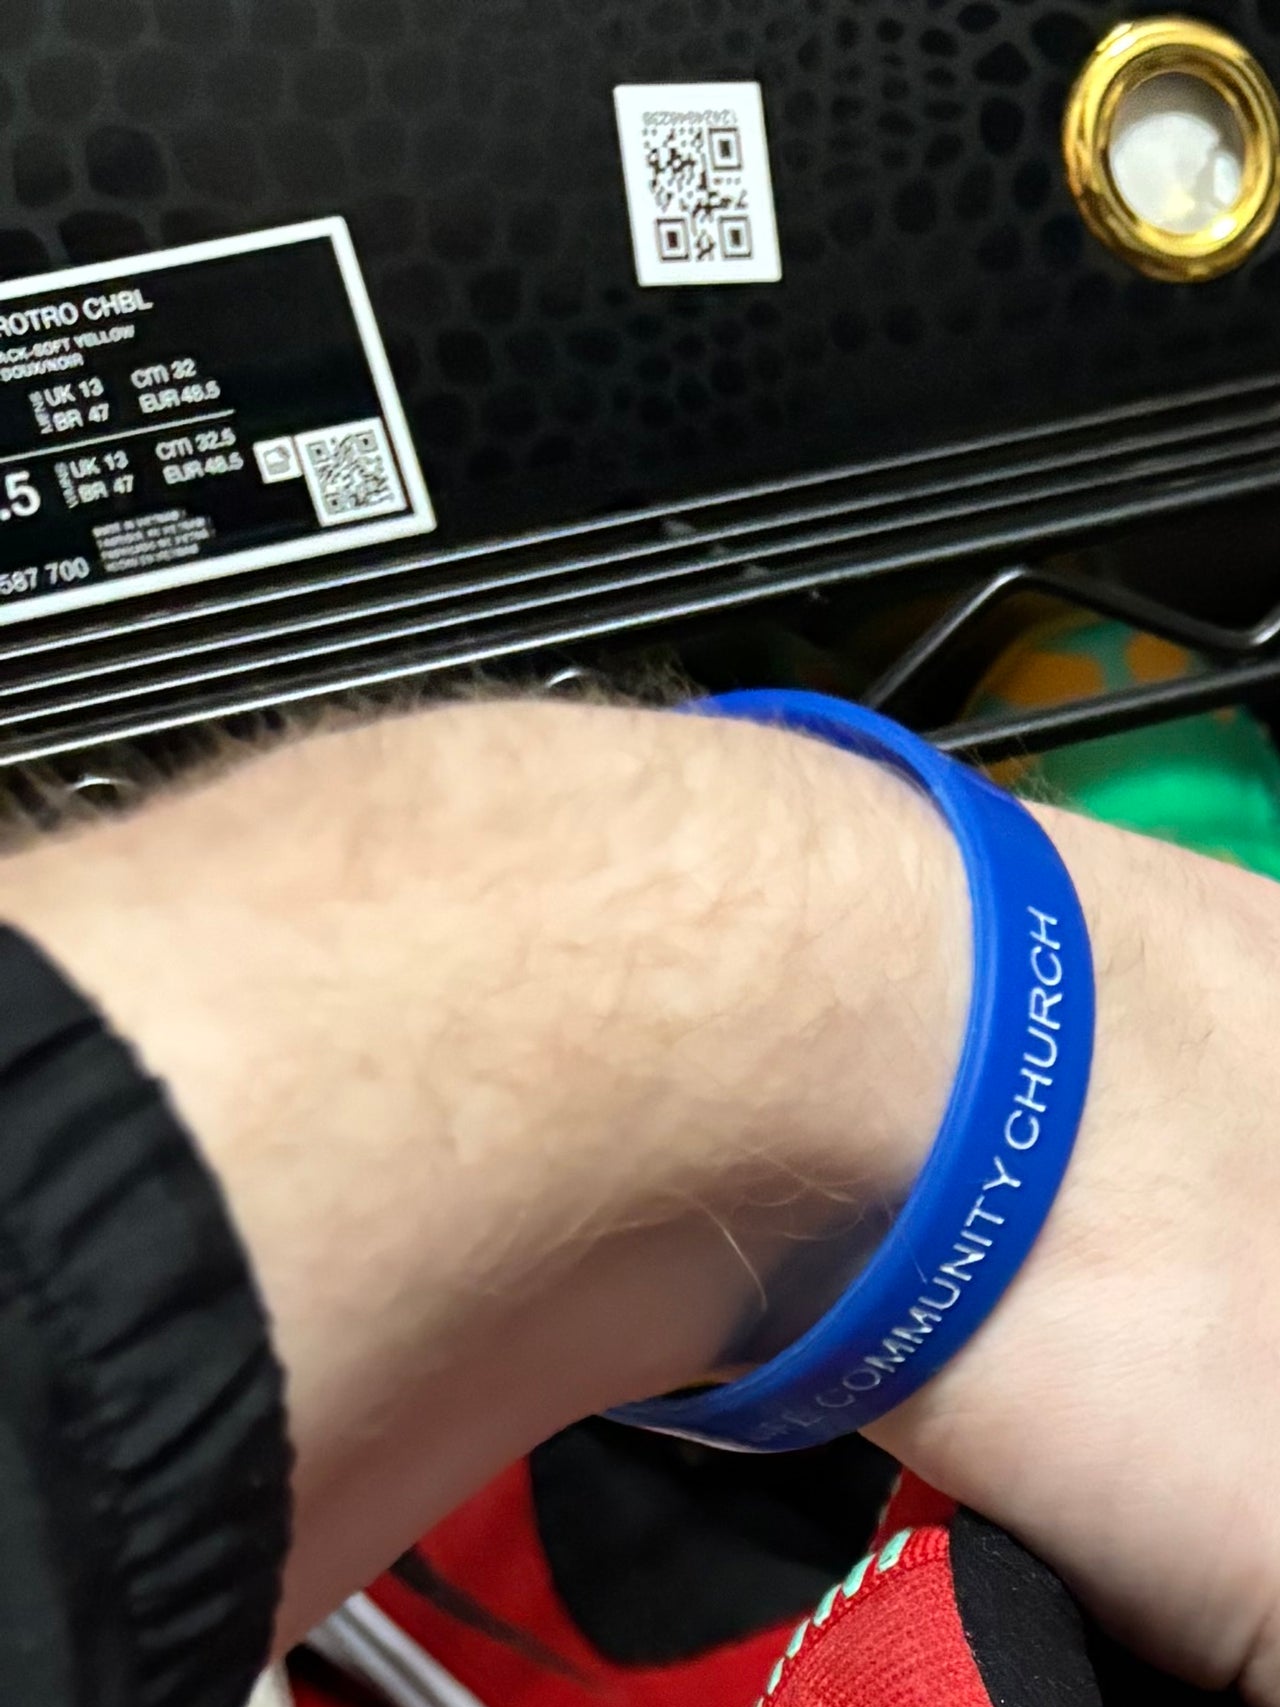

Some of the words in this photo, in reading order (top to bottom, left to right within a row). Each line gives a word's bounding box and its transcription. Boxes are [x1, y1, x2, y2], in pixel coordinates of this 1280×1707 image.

[82, 288, 155, 322] CHBL
[73, 323, 136, 349] YELLOW
[44, 383, 77, 408] UK
[78, 376, 105, 399] 13
[138, 387, 181, 414] EUR
[52, 407, 85, 433] BR
[88, 402, 110, 423] 47
[69, 456, 102, 480] UK
[103, 449, 130, 472] 13
[162, 459, 205, 485] EUR
[78, 480, 110, 504] BR
[112, 473, 135, 495] 47
[44, 556, 91, 586] 700
[814, 1155, 1023, 1409] COMMUNITY
[1003, 904, 1064, 1152] CHURCH
